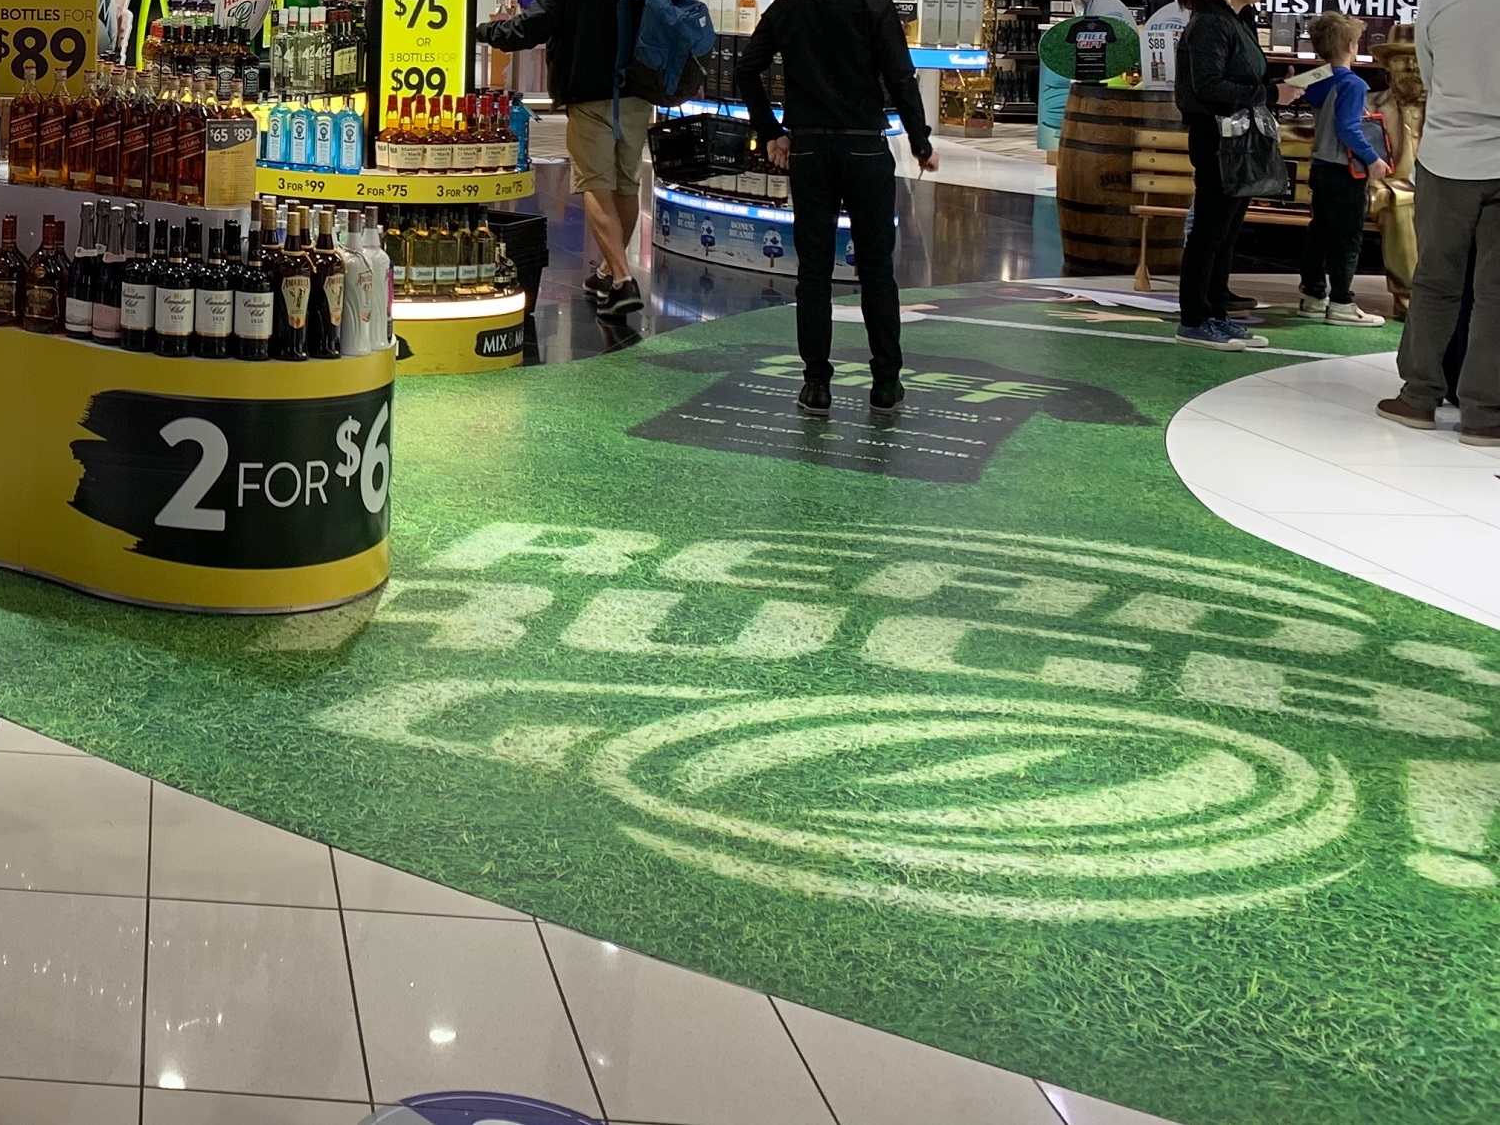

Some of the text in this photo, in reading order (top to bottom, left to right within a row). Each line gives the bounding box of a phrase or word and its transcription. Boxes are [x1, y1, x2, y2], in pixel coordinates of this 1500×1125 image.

[1, 9, 60, 21] BOTTLES
[63, 9, 94, 22] FOR
[1149, 38, 1165, 49] $88
[210, 128, 252, 142] $65 $89
[153, 400, 390, 532] 2 FOR $6
